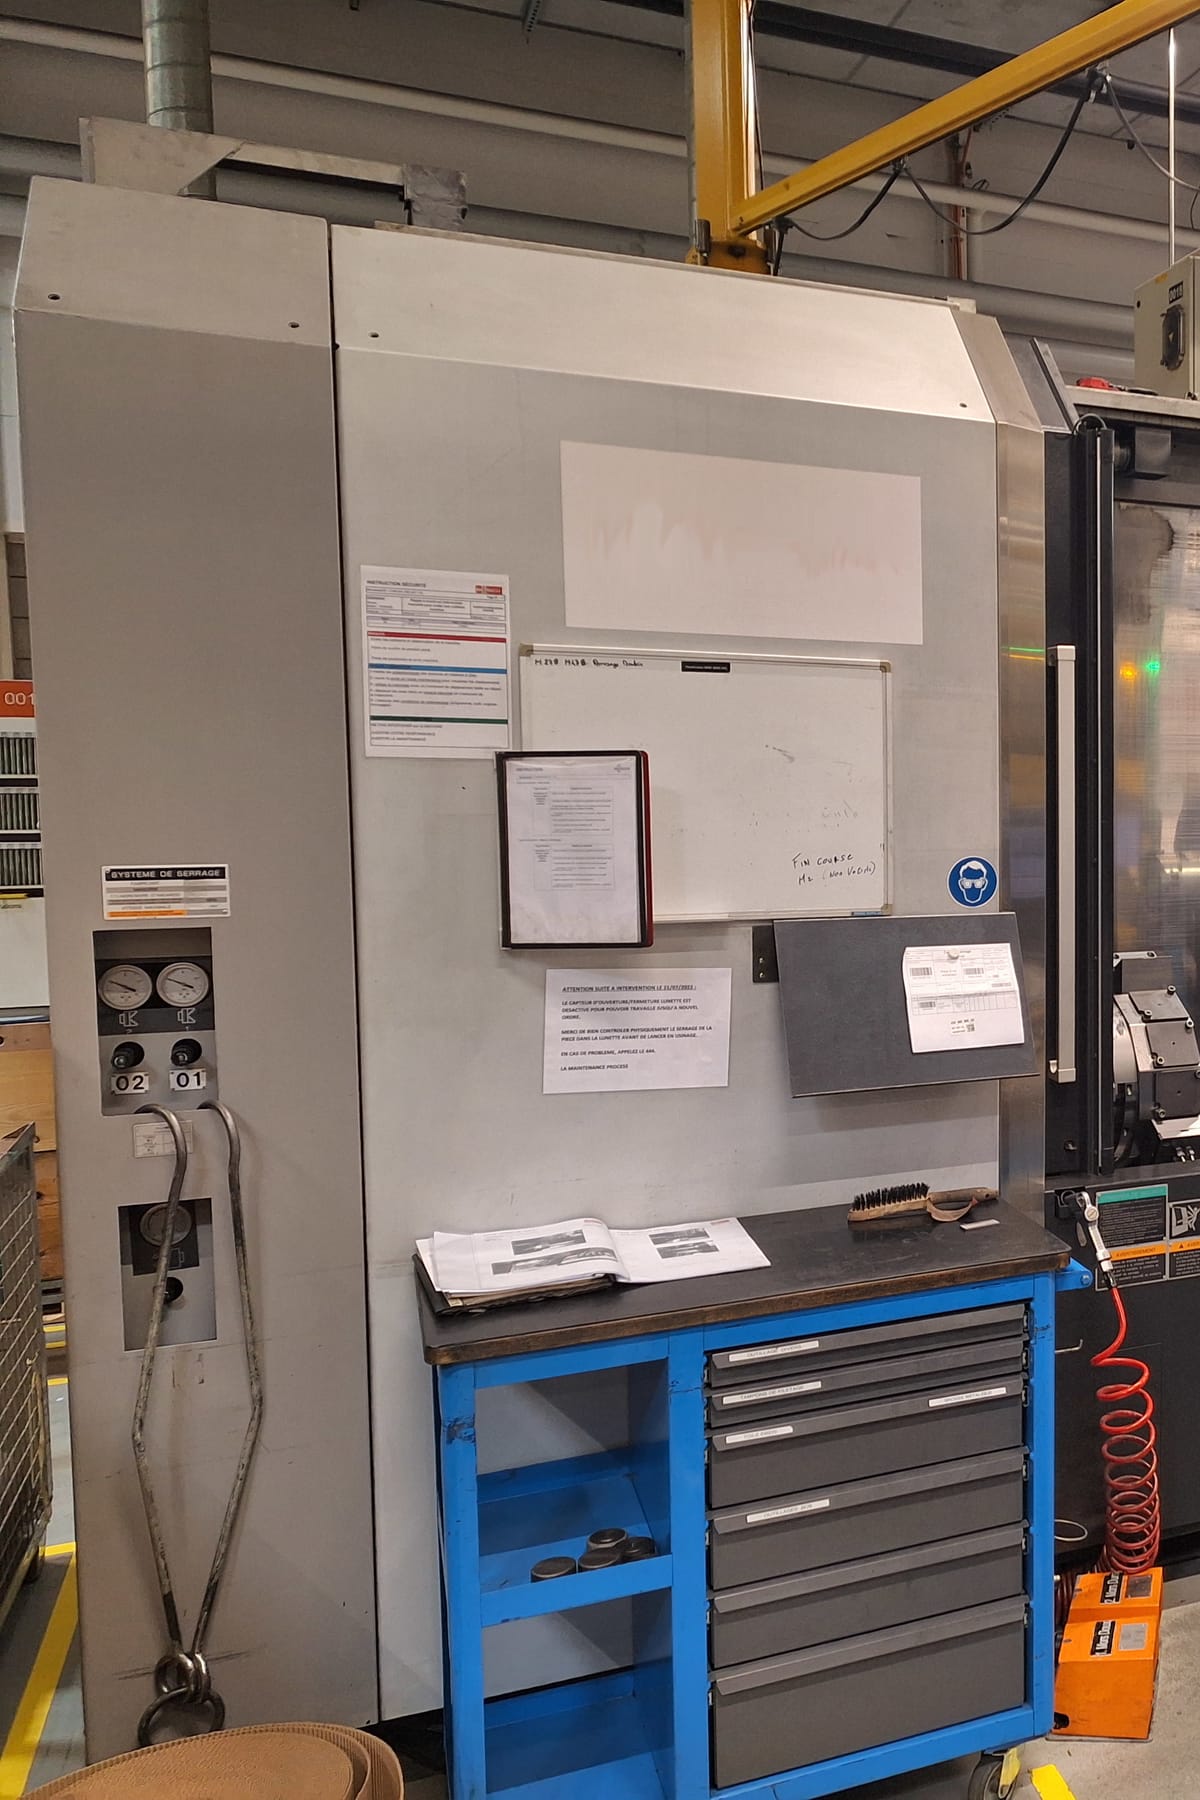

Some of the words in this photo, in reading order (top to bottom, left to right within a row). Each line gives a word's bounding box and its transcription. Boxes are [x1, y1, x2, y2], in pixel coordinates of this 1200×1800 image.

[159, 870, 172, 878] DE
[176, 869, 221, 877] SERRAGE
[176, 1071, 201, 1088] 01
